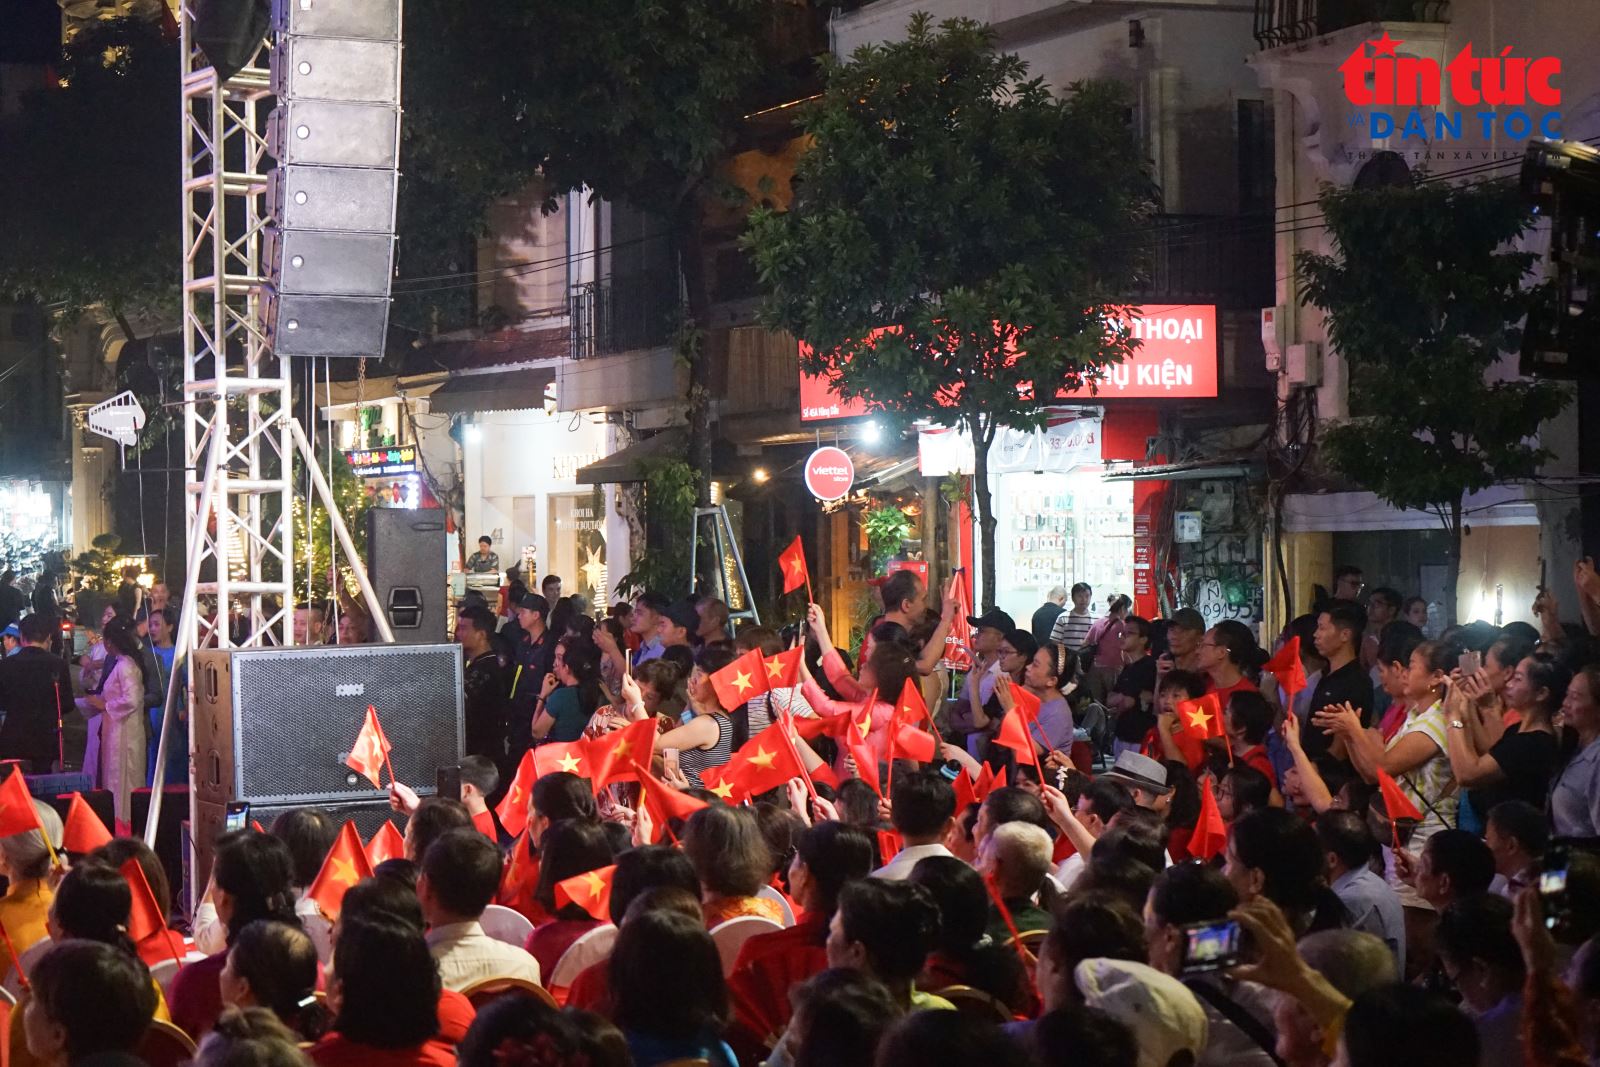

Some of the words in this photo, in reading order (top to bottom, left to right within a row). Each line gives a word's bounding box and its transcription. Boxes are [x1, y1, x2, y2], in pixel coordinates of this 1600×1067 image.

[1130, 318, 1203, 344] THOẠI
[1137, 357, 1193, 390] KIỆN
[812, 466, 848, 475] viettel
